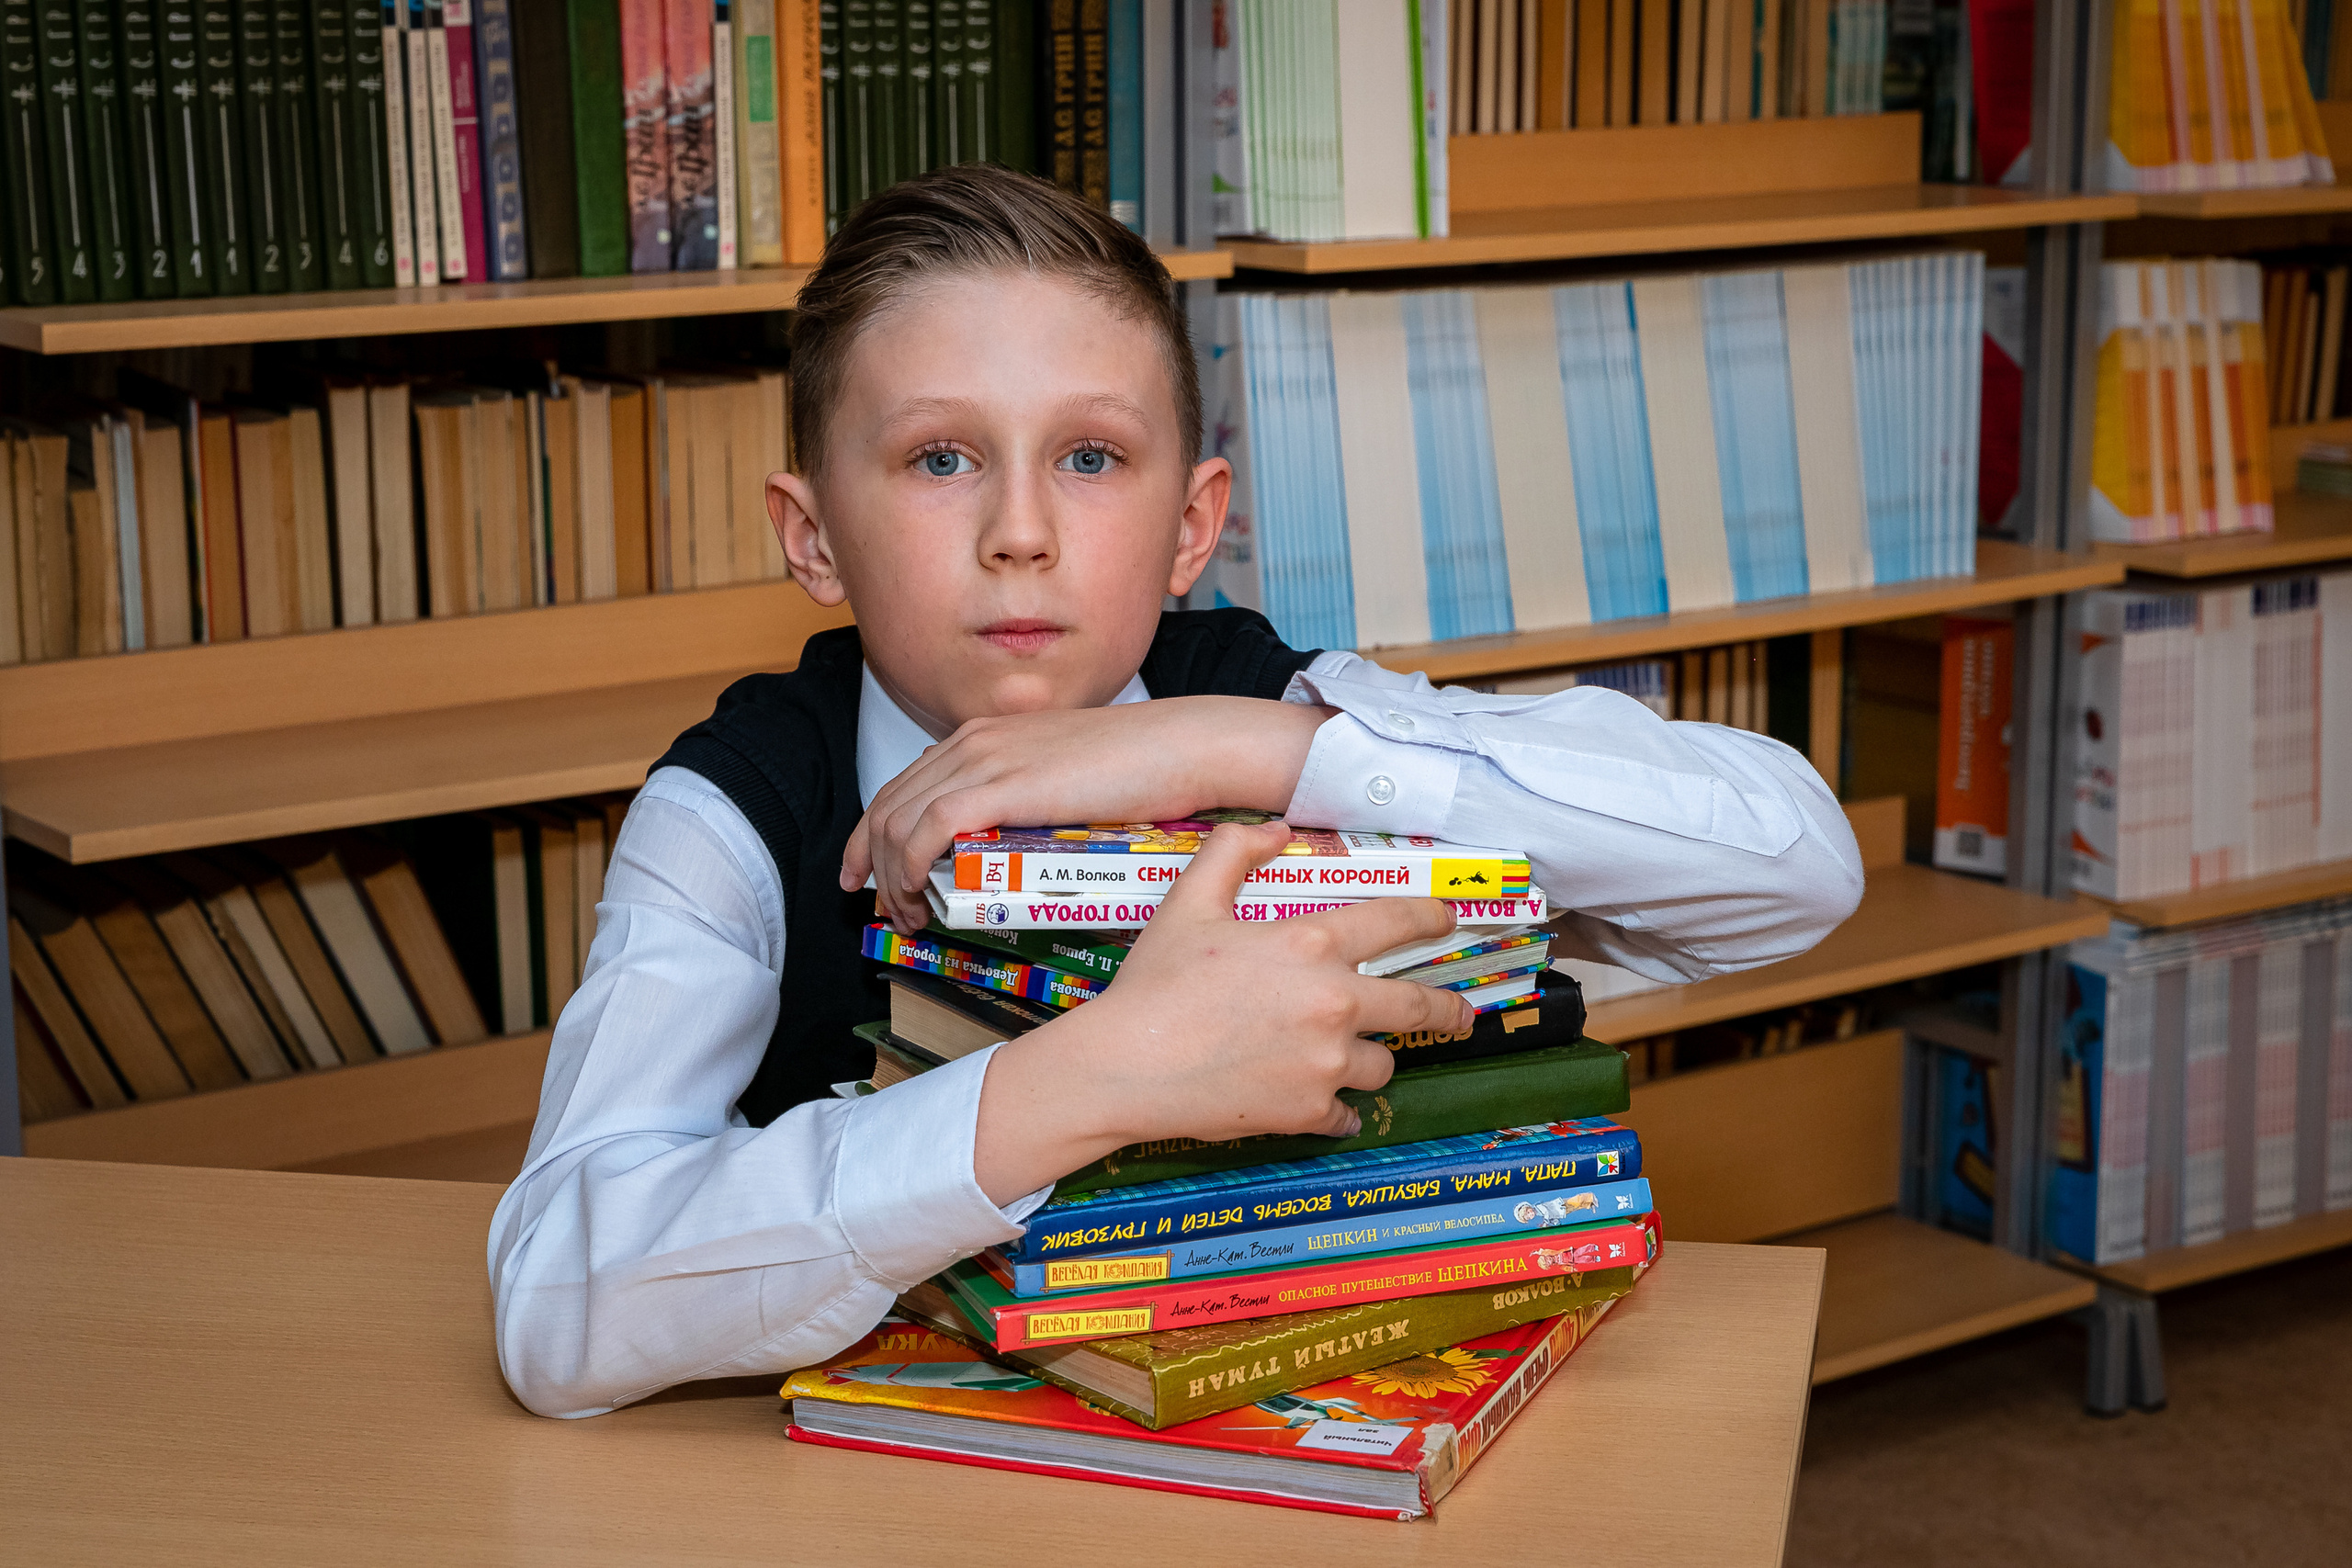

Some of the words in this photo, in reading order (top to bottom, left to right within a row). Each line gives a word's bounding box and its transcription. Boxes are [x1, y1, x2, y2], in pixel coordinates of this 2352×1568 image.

[73, 250, 87, 278] 4
[153, 249, 167, 278] 2
[190, 248, 202, 278] 1
[1039, 869, 1053, 881] А.
[1057, 869, 1073, 881] М.
[1076, 869, 1126, 882] Волков
[1244, 866, 1314, 885] ЕМНЫХ
[1319, 866, 1410, 885] КОРОЛЕЙ
[1027, 903, 1112, 922] ГОРОДА
[1522, 899, 1543, 917] А.
[986, 926, 1019, 945] Конё
[899, 944, 943, 966] города
[944, 956, 959, 969] из
[1052, 943, 1096, 967] Ершов
[962, 960, 1019, 987] Девочка
[1450, 1173, 1511, 1193] МАМА,
[1520, 1160, 1577, 1183] ПАПА,
[1342, 1179, 1441, 1208] БАБУШКА,
[1252, 1192, 1332, 1222] ВОСЕМЬ
[1156, 1217, 1171, 1235] И
[1180, 1205, 1243, 1235] ДЕТЕЙ
[1041, 1220, 1148, 1252] ГРУЗОВИК
[1052, 1262, 1098, 1282] ВЕСЁЛАЯ
[1103, 1260, 1163, 1280] КОМПАНИЯ
[1184, 1247, 1248, 1268] Анне-Кат.
[1249, 1241, 1295, 1259] Вестли
[1307, 1228, 1379, 1251] ЩЕПКИН
[1382, 1227, 1390, 1238] И
[1394, 1220, 1442, 1237] КРАСНЫЙ
[1444, 1213, 1506, 1231] ВЕЛОСИПЕД
[1033, 1314, 1080, 1334] ВЕСЁЛАЯ
[1086, 1312, 1146, 1331] КОМПАНИЯ
[1170, 1299, 1228, 1317] Анне-Кат.
[1229, 1293, 1271, 1309] Вестли
[1278, 1283, 1337, 1303] ОПАСНОЕ
[1341, 1271, 1432, 1295] ПУТЕШЕСТВИЕ
[1437, 1257, 1529, 1283] ЩЕПКИНА
[876, 1333, 944, 1351] УКА
[1294, 1318, 1409, 1370] ЖЕЛТЫЙ
[1189, 1355, 1282, 1398] ТУМАН
[1323, 1434, 1393, 1447] Читальный
